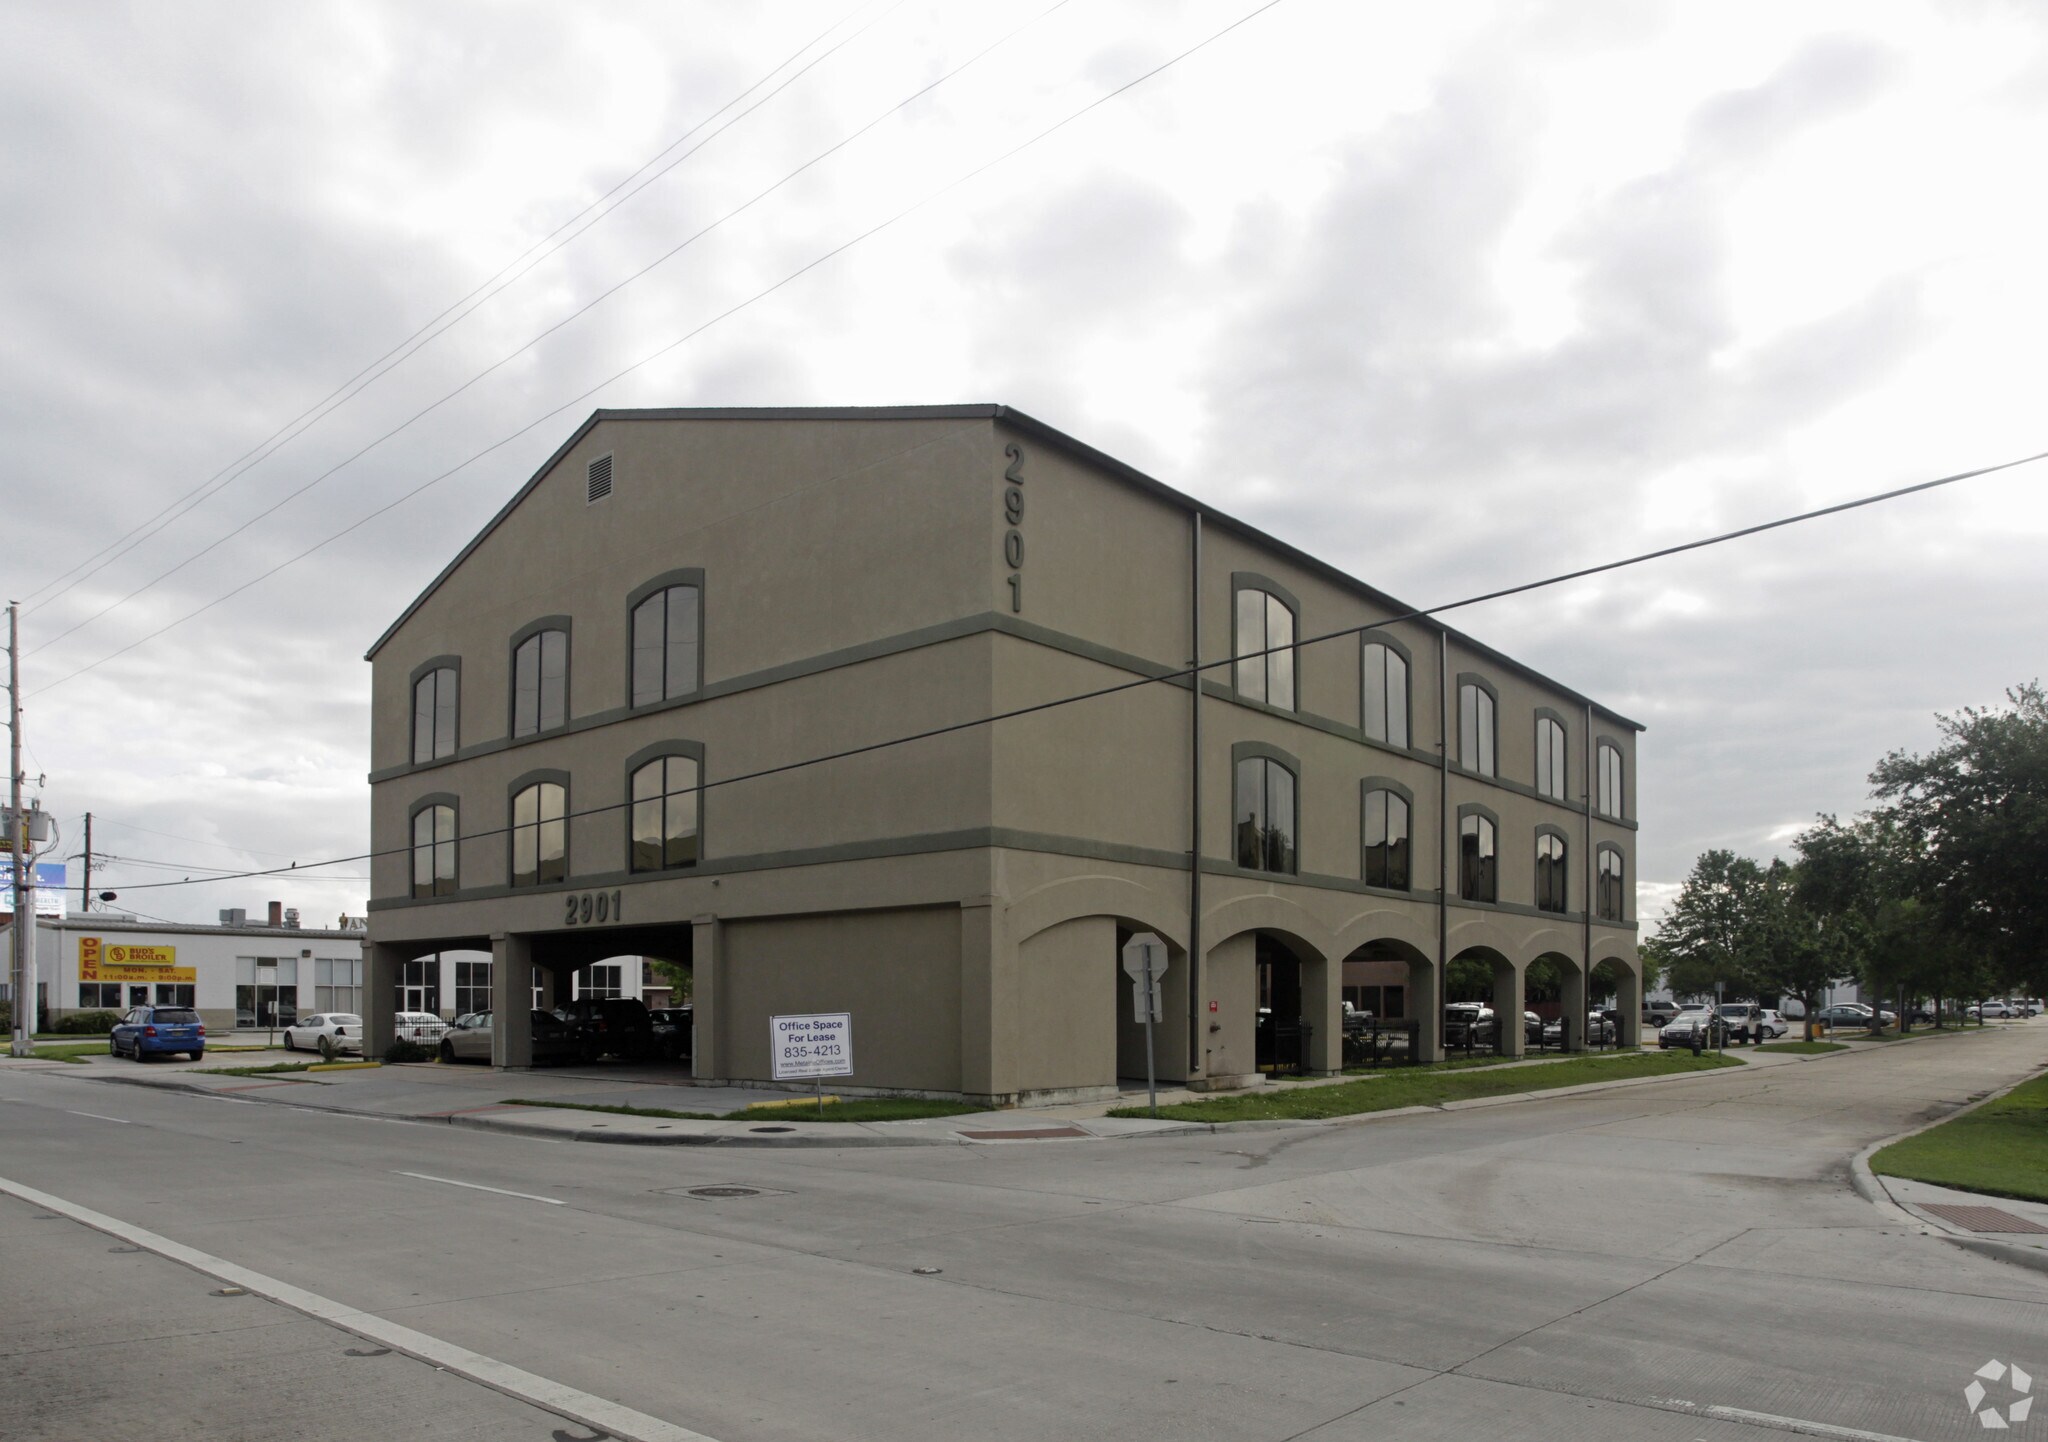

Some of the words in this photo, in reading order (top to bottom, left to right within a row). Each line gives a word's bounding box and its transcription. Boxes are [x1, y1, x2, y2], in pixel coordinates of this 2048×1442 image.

[1005, 442, 1025, 613] 2901
[565, 890, 621, 925] 2901
[82, 938, 98, 980] OPEN
[779, 1022, 811, 1031] Office
[813, 1021, 843, 1031] Space
[788, 1034, 804, 1043] For
[807, 1034, 836, 1042] Lease
[784, 1044, 841, 1058] 835-4213
